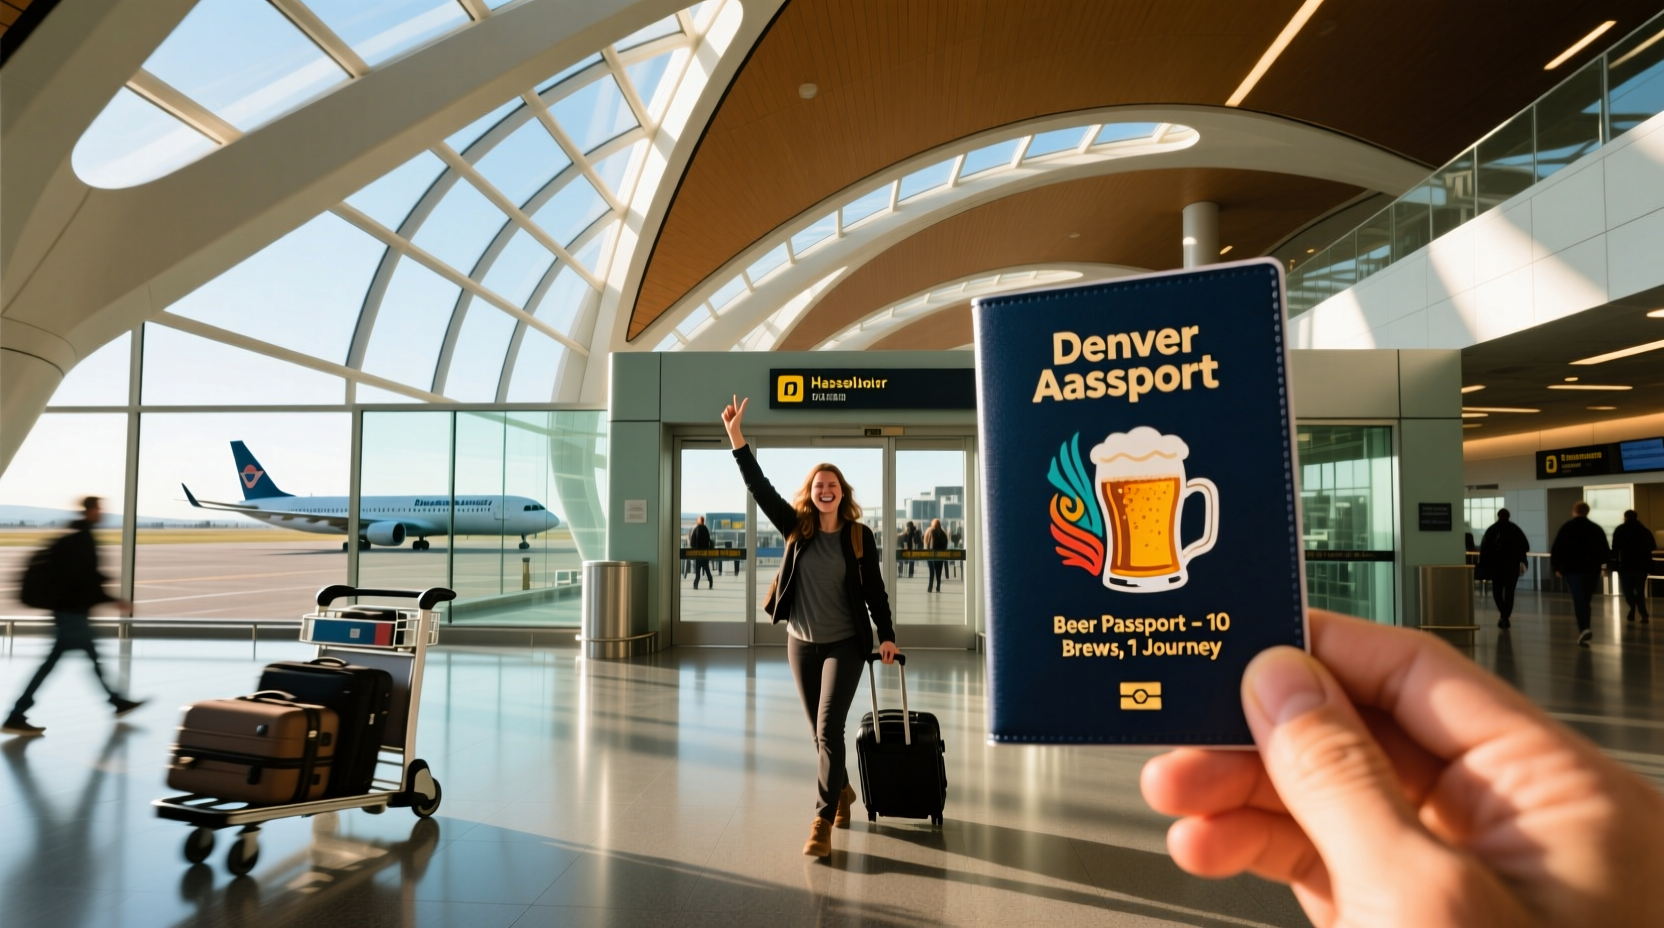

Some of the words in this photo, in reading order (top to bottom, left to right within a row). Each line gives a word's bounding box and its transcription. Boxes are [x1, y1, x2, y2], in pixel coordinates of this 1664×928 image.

[1052, 325, 1199, 366] Denver
[1032, 354, 1220, 404] Aassport
[1053, 615, 1098, 634] Beer
[1101, 614, 1187, 637] Passport
[1206, 612, 1231, 632] 10
[1062, 639, 1125, 660] Brews,
[1127, 638, 1137, 657] 1
[1142, 638, 1223, 661] Journey
